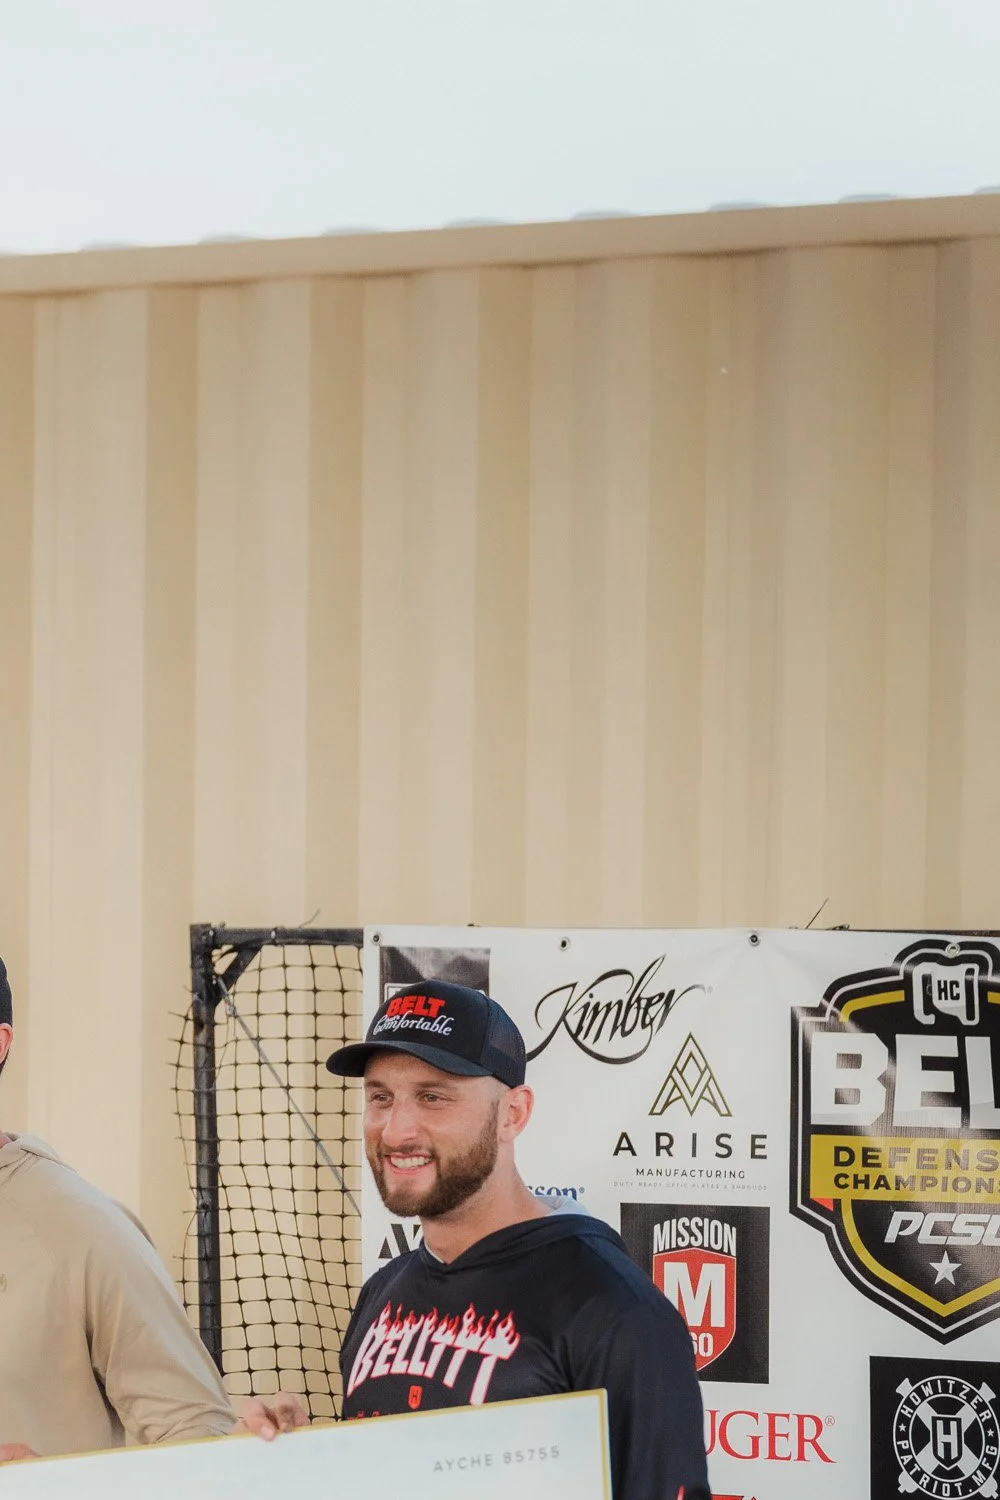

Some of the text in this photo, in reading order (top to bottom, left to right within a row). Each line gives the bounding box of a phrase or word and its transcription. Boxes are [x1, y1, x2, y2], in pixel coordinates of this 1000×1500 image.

[937, 978, 961, 1001] HC
[386, 995, 446, 1019] BELT
[526, 953, 707, 1065] Kimber
[372, 1010, 455, 1036] Comfortable
[810, 1031, 1000, 1129] BEL
[612, 1131, 768, 1160] ARISE
[832, 1144, 999, 1172] DEFENS
[635, 1168, 746, 1179] MANUFACTURING
[832, 1172, 1000, 1194] CHAMPION
[653, 1217, 737, 1257] MISSION
[663, 1261, 726, 1328] M
[900, 1379, 992, 1423] HOWITZER
[936, 1419, 959, 1460] H
[432, 1453, 494, 1473] AYCHE
